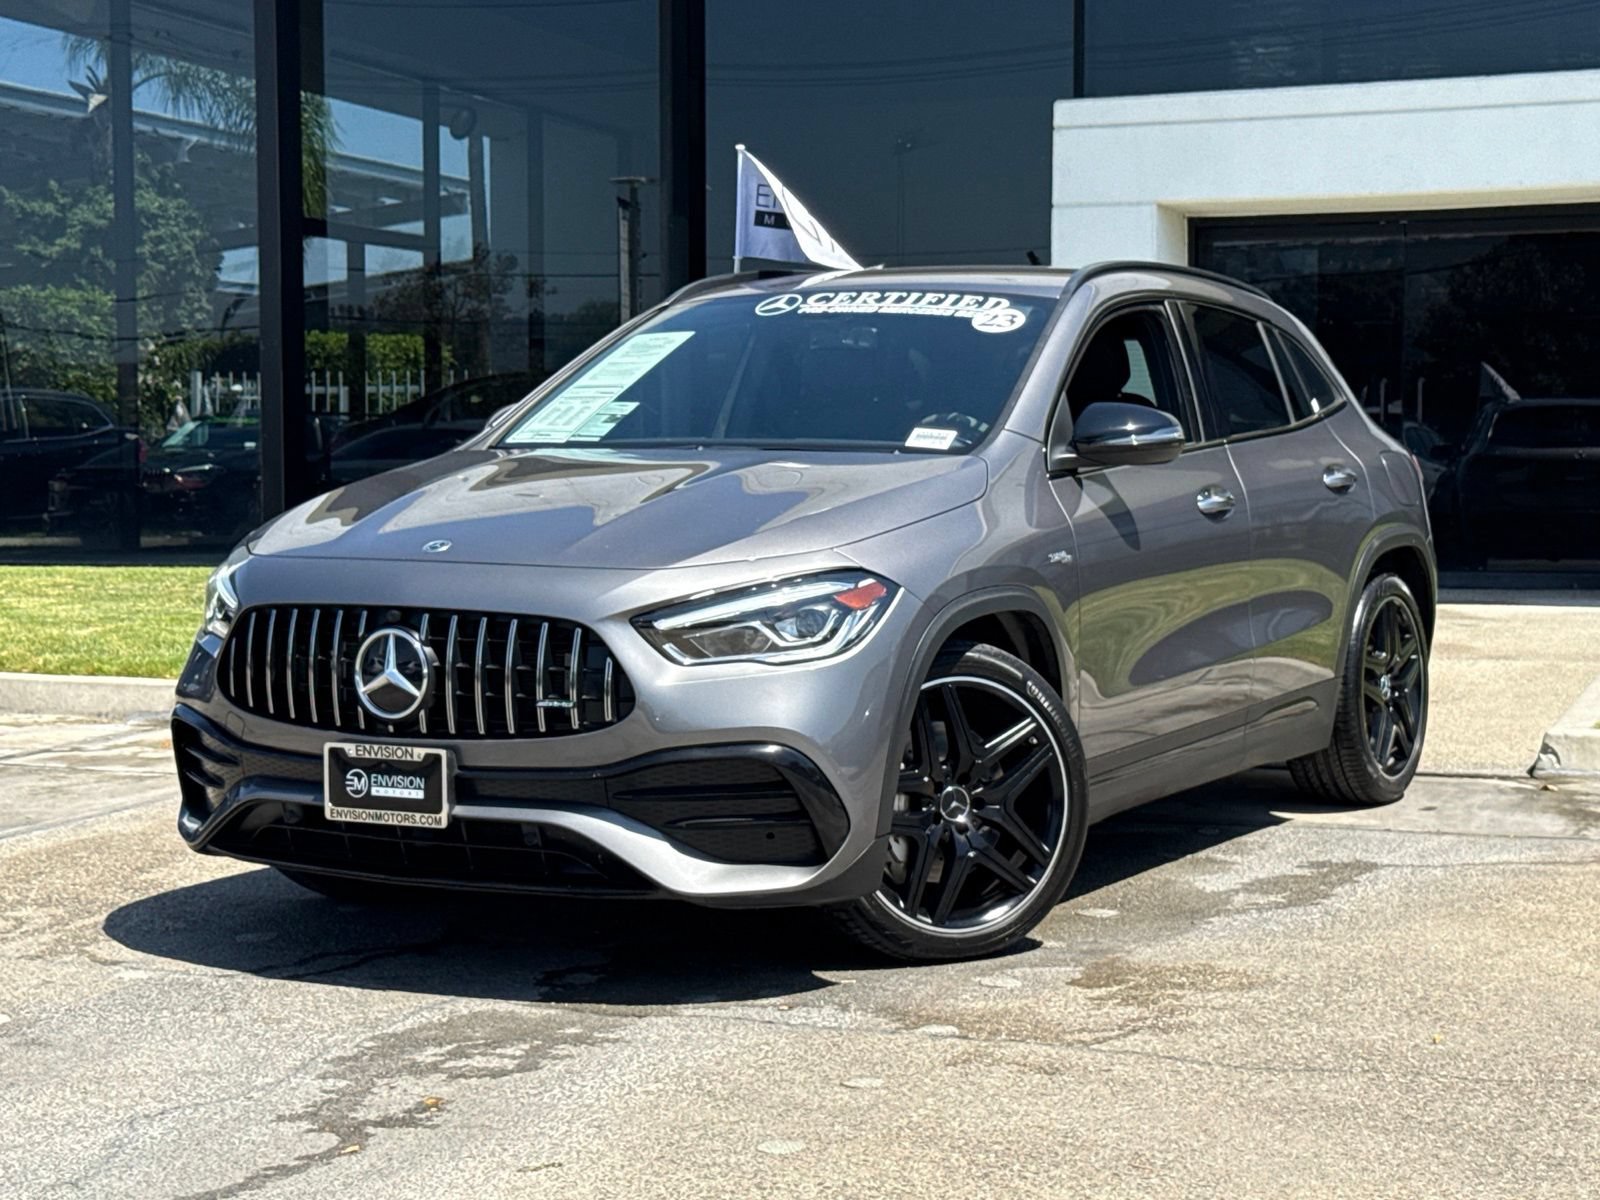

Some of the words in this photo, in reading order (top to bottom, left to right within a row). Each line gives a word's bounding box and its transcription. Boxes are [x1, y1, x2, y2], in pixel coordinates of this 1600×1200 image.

[806, 291, 1011, 310] CERTIFIED
[977, 313, 1019, 328] 23
[355, 744, 414, 760] ENVISION
[370, 773, 425, 789] ENVISION
[329, 808, 443, 827] ENVISIONMOTORS.COM
